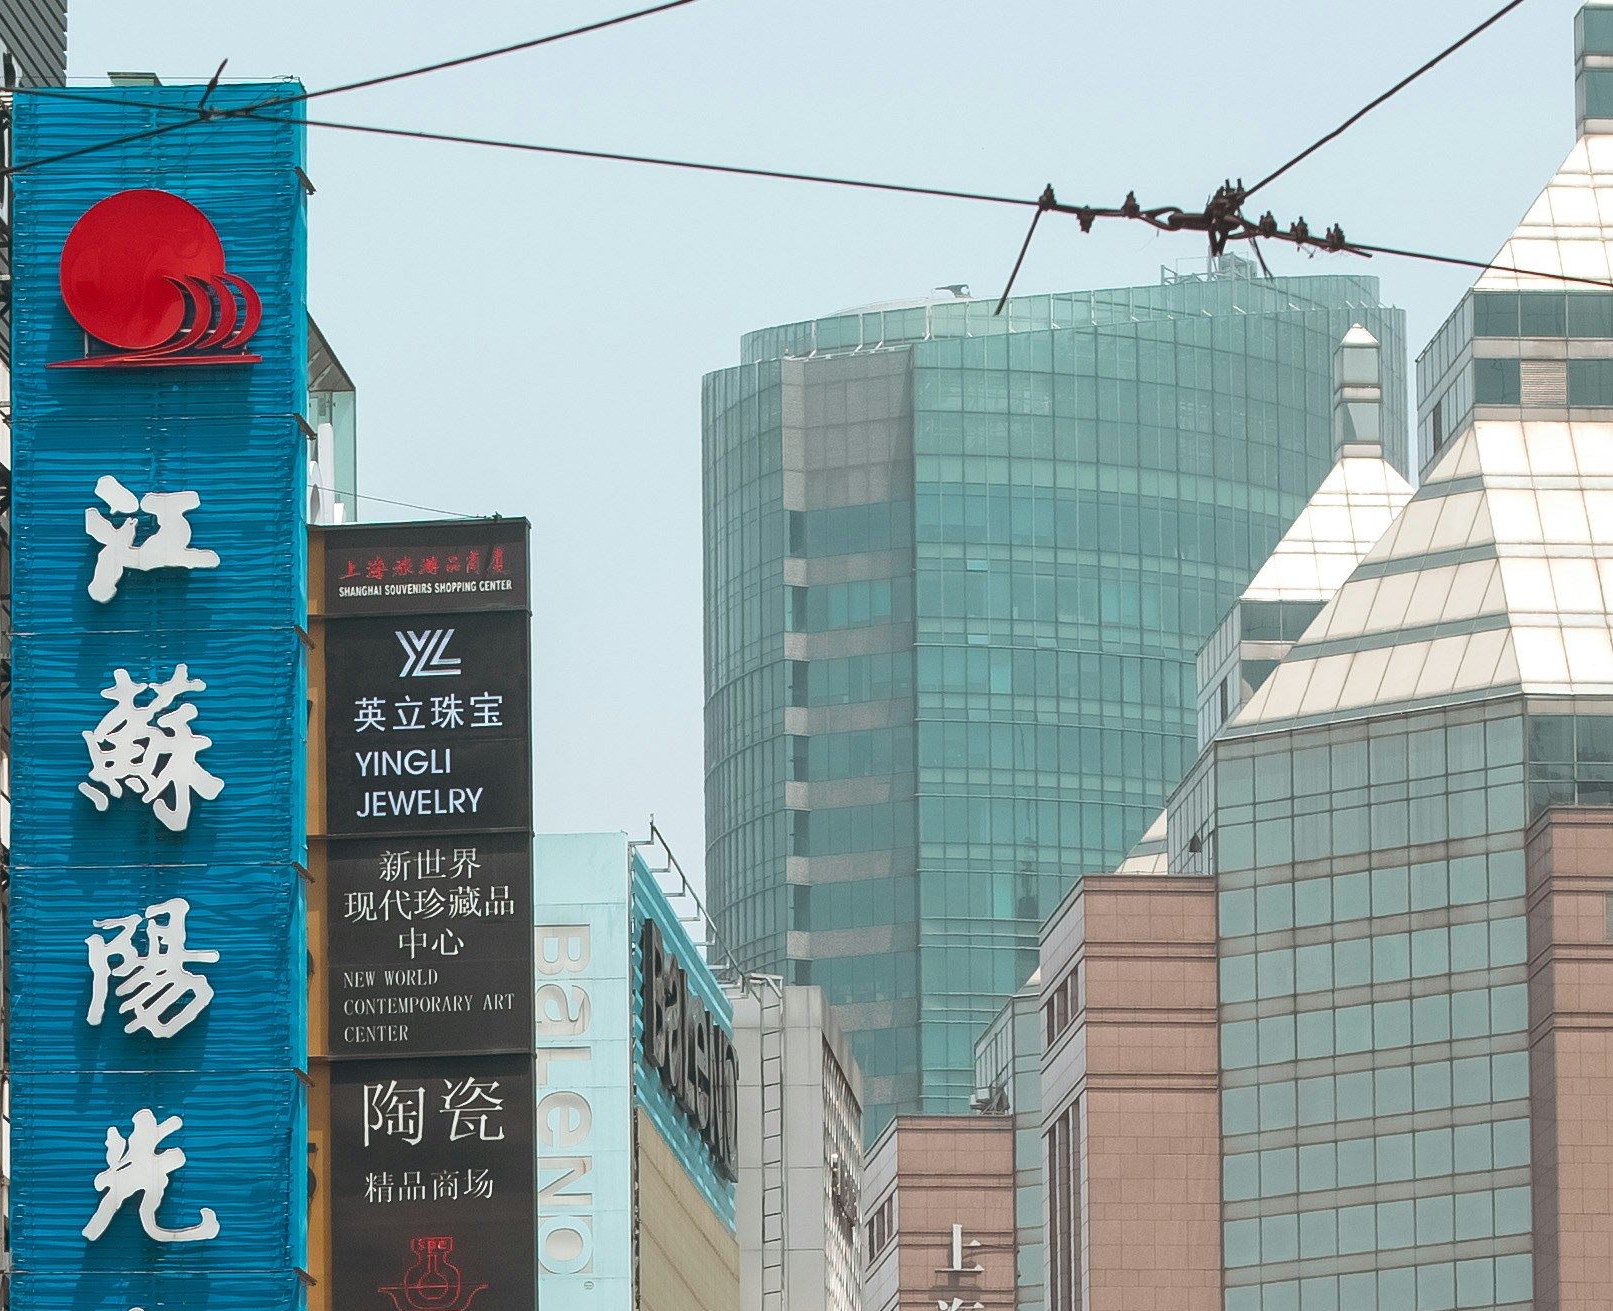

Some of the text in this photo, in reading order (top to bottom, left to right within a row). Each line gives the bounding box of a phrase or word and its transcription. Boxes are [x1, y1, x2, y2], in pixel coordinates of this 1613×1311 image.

[338, 579, 513, 598] SHANGHAI SOUVENIRS SHOPPING CENTER
[353, 691, 503, 733] 英立珠宝
[354, 748, 451, 777] YINGLI
[356, 786, 484, 818] JEWELRY
[378, 847, 482, 883] 新世界
[343, 885, 516, 924] 现代珍藏品
[398, 926, 465, 960] 中心
[343, 969, 438, 989] NEW WORLD
[343, 993, 516, 1016] CONTEMPORARY ART
[344, 1024, 409, 1043] CENTER
[362, 1076, 506, 1148] 陶瓷
[363, 1168, 494, 1203] 精品商场
